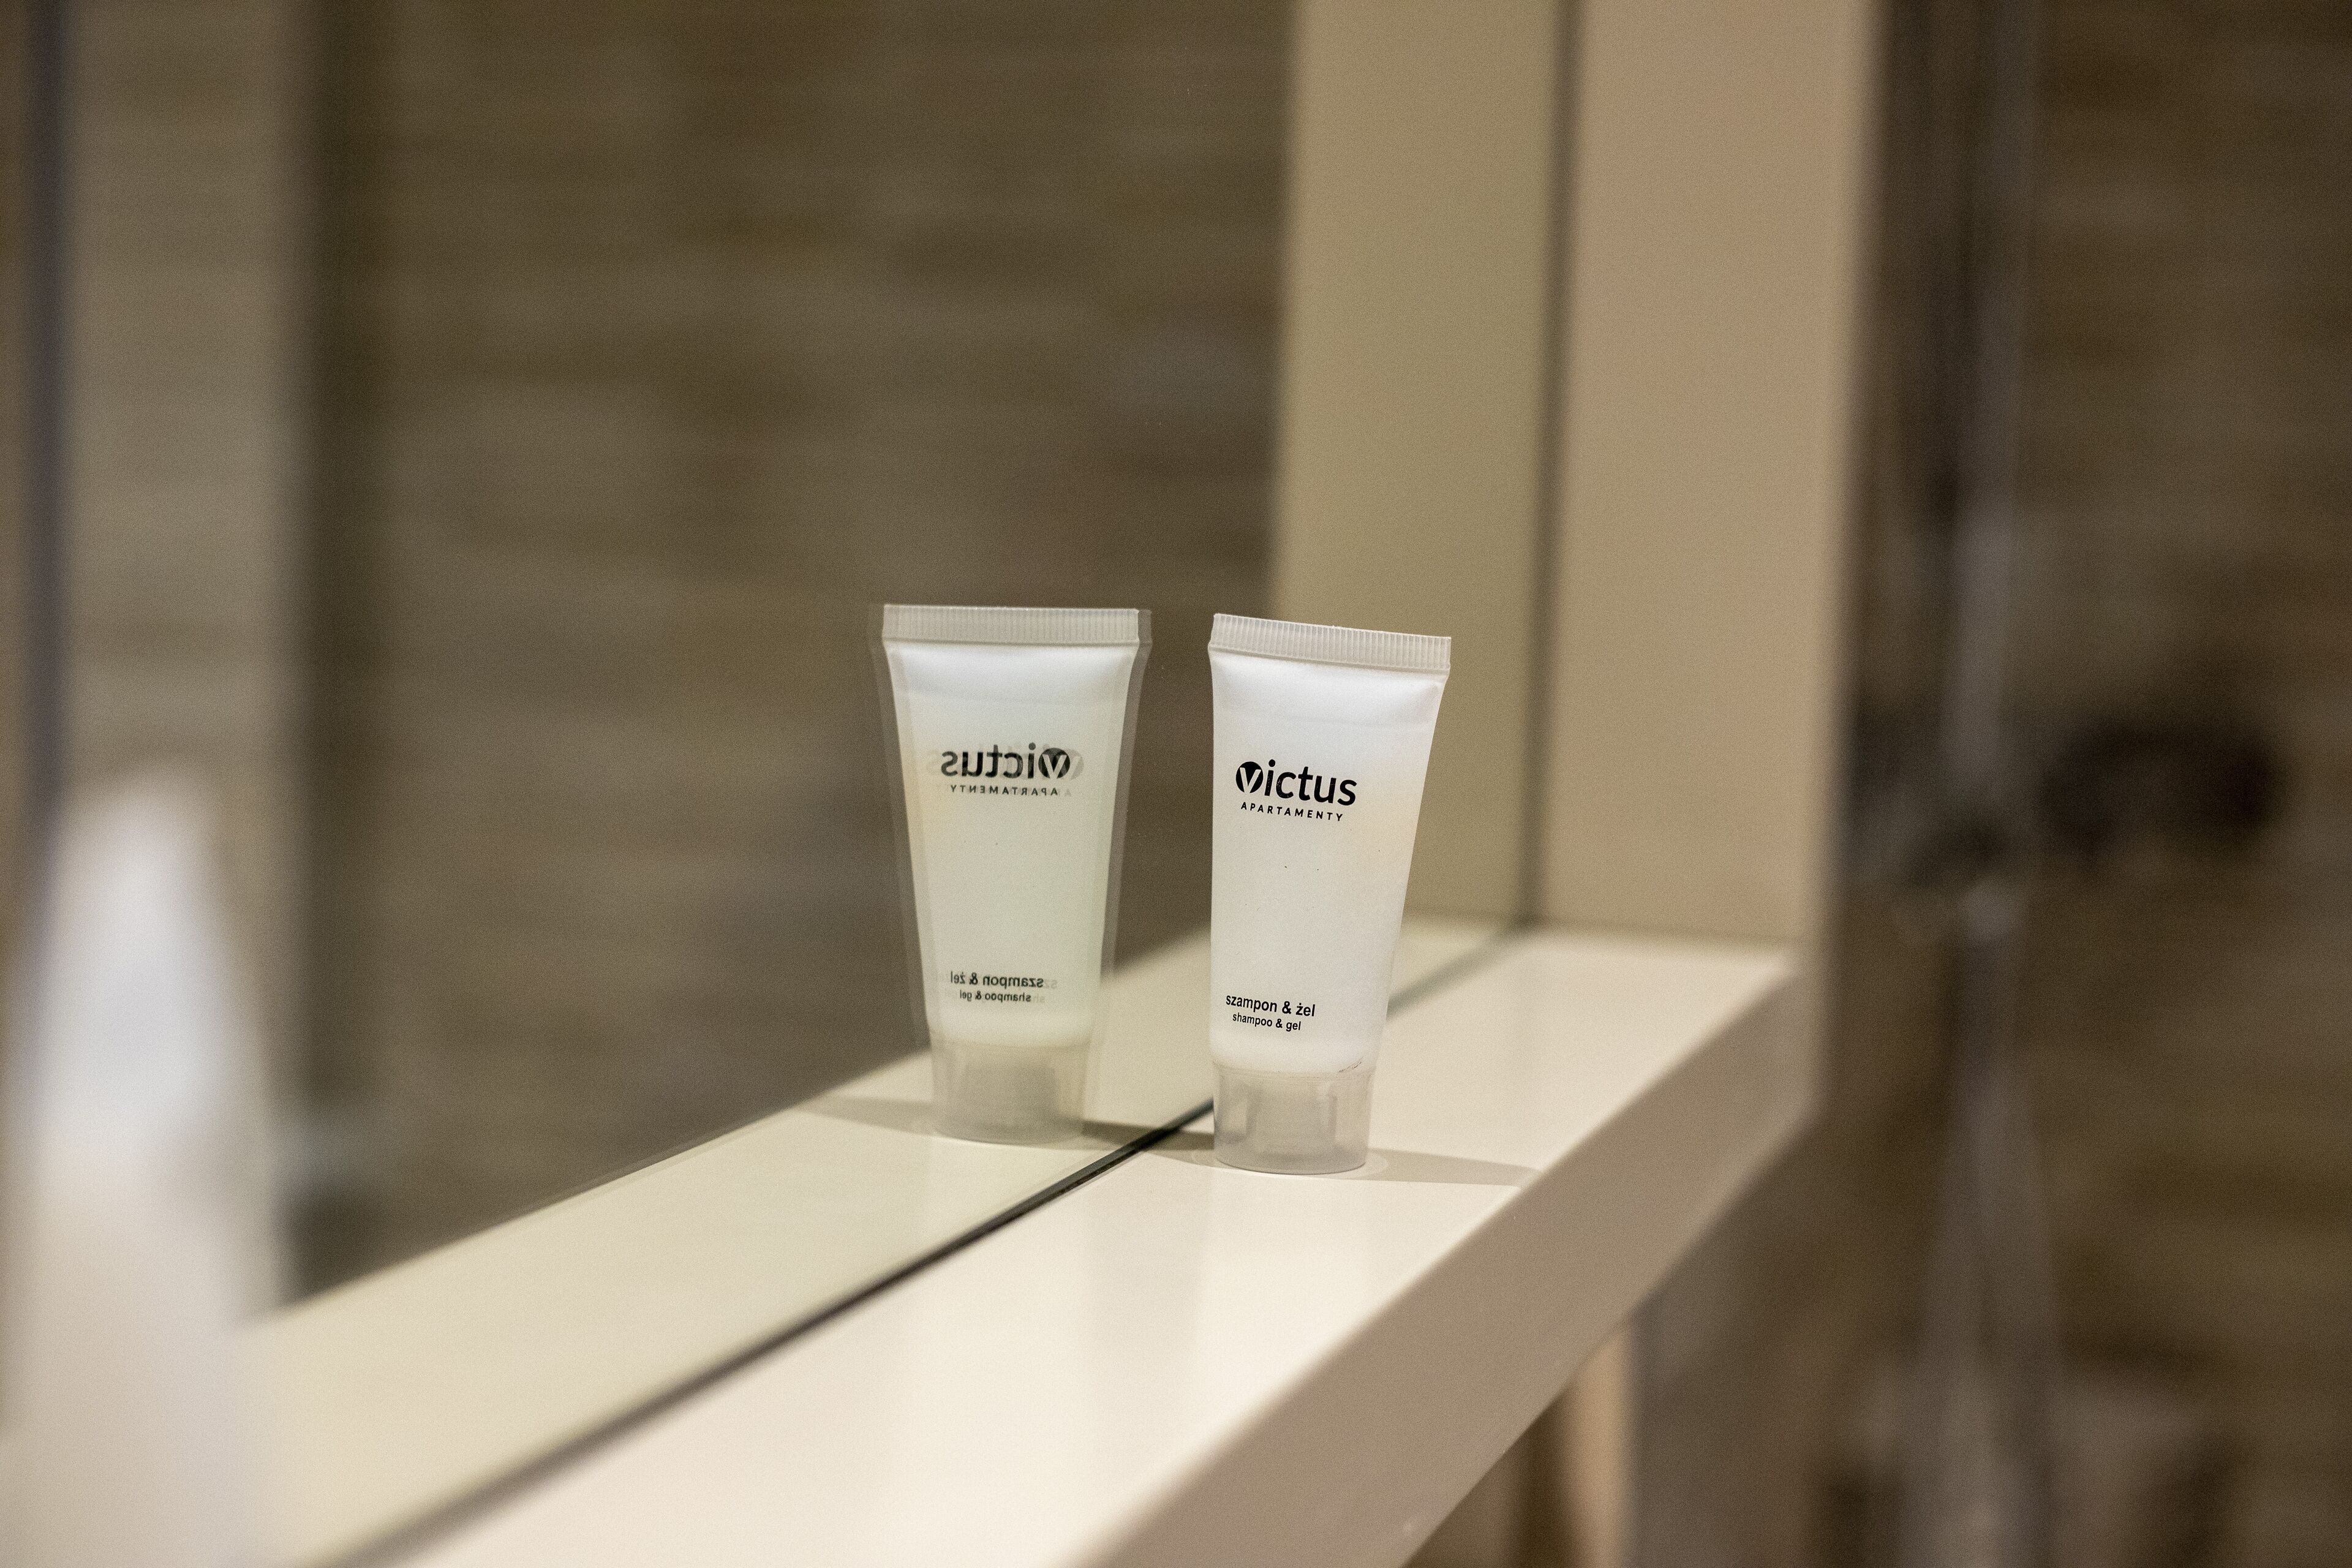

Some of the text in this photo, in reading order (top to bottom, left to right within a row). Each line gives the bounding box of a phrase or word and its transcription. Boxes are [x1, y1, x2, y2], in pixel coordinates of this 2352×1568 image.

[1241, 802, 1343, 821] APARTAMENTY
[1226, 995, 1316, 1017] szampon & żel
[1232, 1012, 1301, 1032] shampoo & gel
